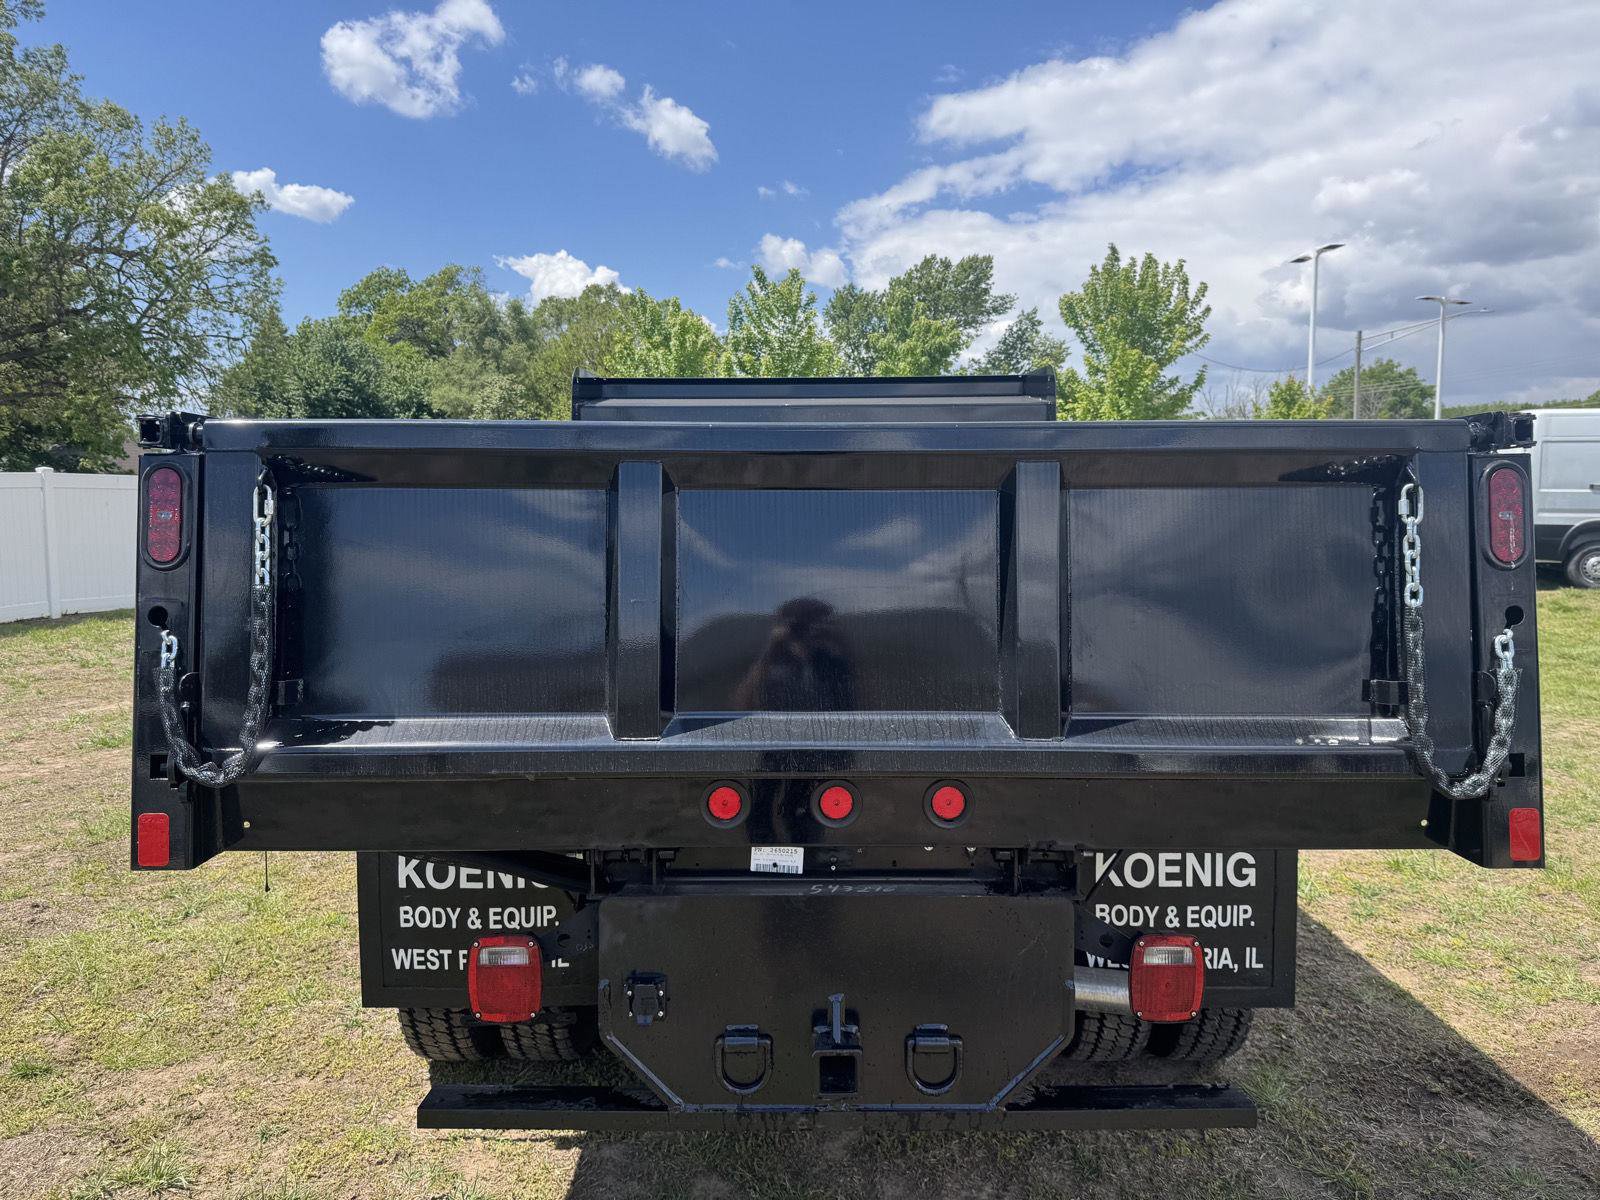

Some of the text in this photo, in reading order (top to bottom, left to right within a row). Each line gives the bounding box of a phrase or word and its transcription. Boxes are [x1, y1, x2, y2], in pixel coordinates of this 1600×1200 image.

[398, 855, 550, 889] KOEN
[1095, 852, 1256, 888] KOENIG
[399, 905, 560, 930] BODY & EQUIP.
[1095, 904, 1255, 928] BODY & EQUIP.
[391, 948, 452, 970] WEST
[1245, 947, 1264, 969] IL
